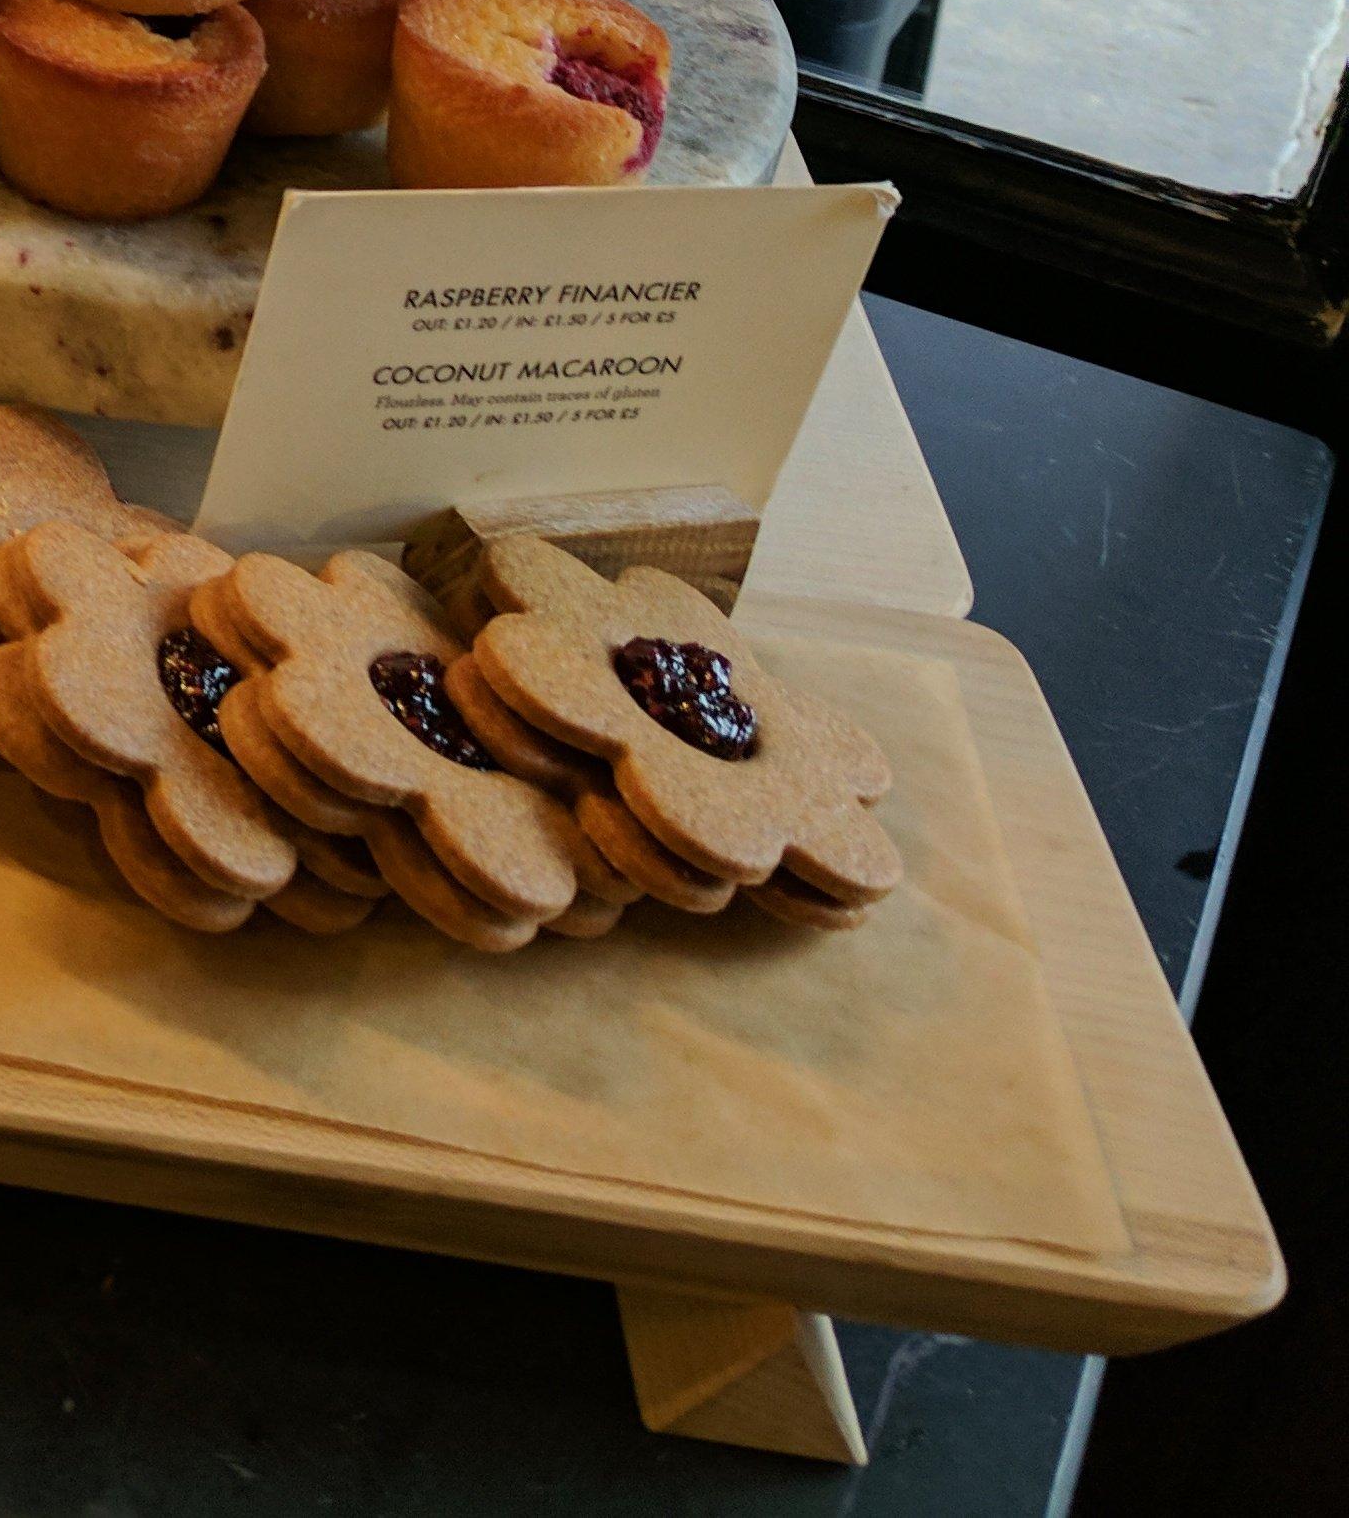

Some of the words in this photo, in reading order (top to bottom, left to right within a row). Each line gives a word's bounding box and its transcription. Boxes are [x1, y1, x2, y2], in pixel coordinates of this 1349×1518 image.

[404, 285, 552, 309] RASPBERRY
[559, 281, 701, 304] FINANCIER
[412, 316, 448, 332] OUT:
[454, 316, 498, 331] £1.20
[502, 314, 512, 330] /
[515, 314, 538, 328] IN:
[544, 313, 587, 327] £1.50
[591, 312, 602, 326] /
[620, 311, 652, 324] FOR
[656, 310, 677, 323] £5
[373, 362, 512, 385] COCONUT
[517, 355, 683, 380] MACAROON
[451, 393, 483, 407] May
[486, 393, 542, 404] contain
[546, 391, 590, 402] traces
[592, 386, 612, 400] of
[612, 385, 661, 402] gluten
[382, 416, 418, 431] OUT:
[423, 415, 468, 429] £1.20
[470, 412, 482, 428] /
[484, 413, 507, 426] IN:
[512, 411, 554, 425] £1.50
[556, 410, 568, 423] /
[585, 408, 617, 422] FOR
[620, 407, 641, 421] £5
